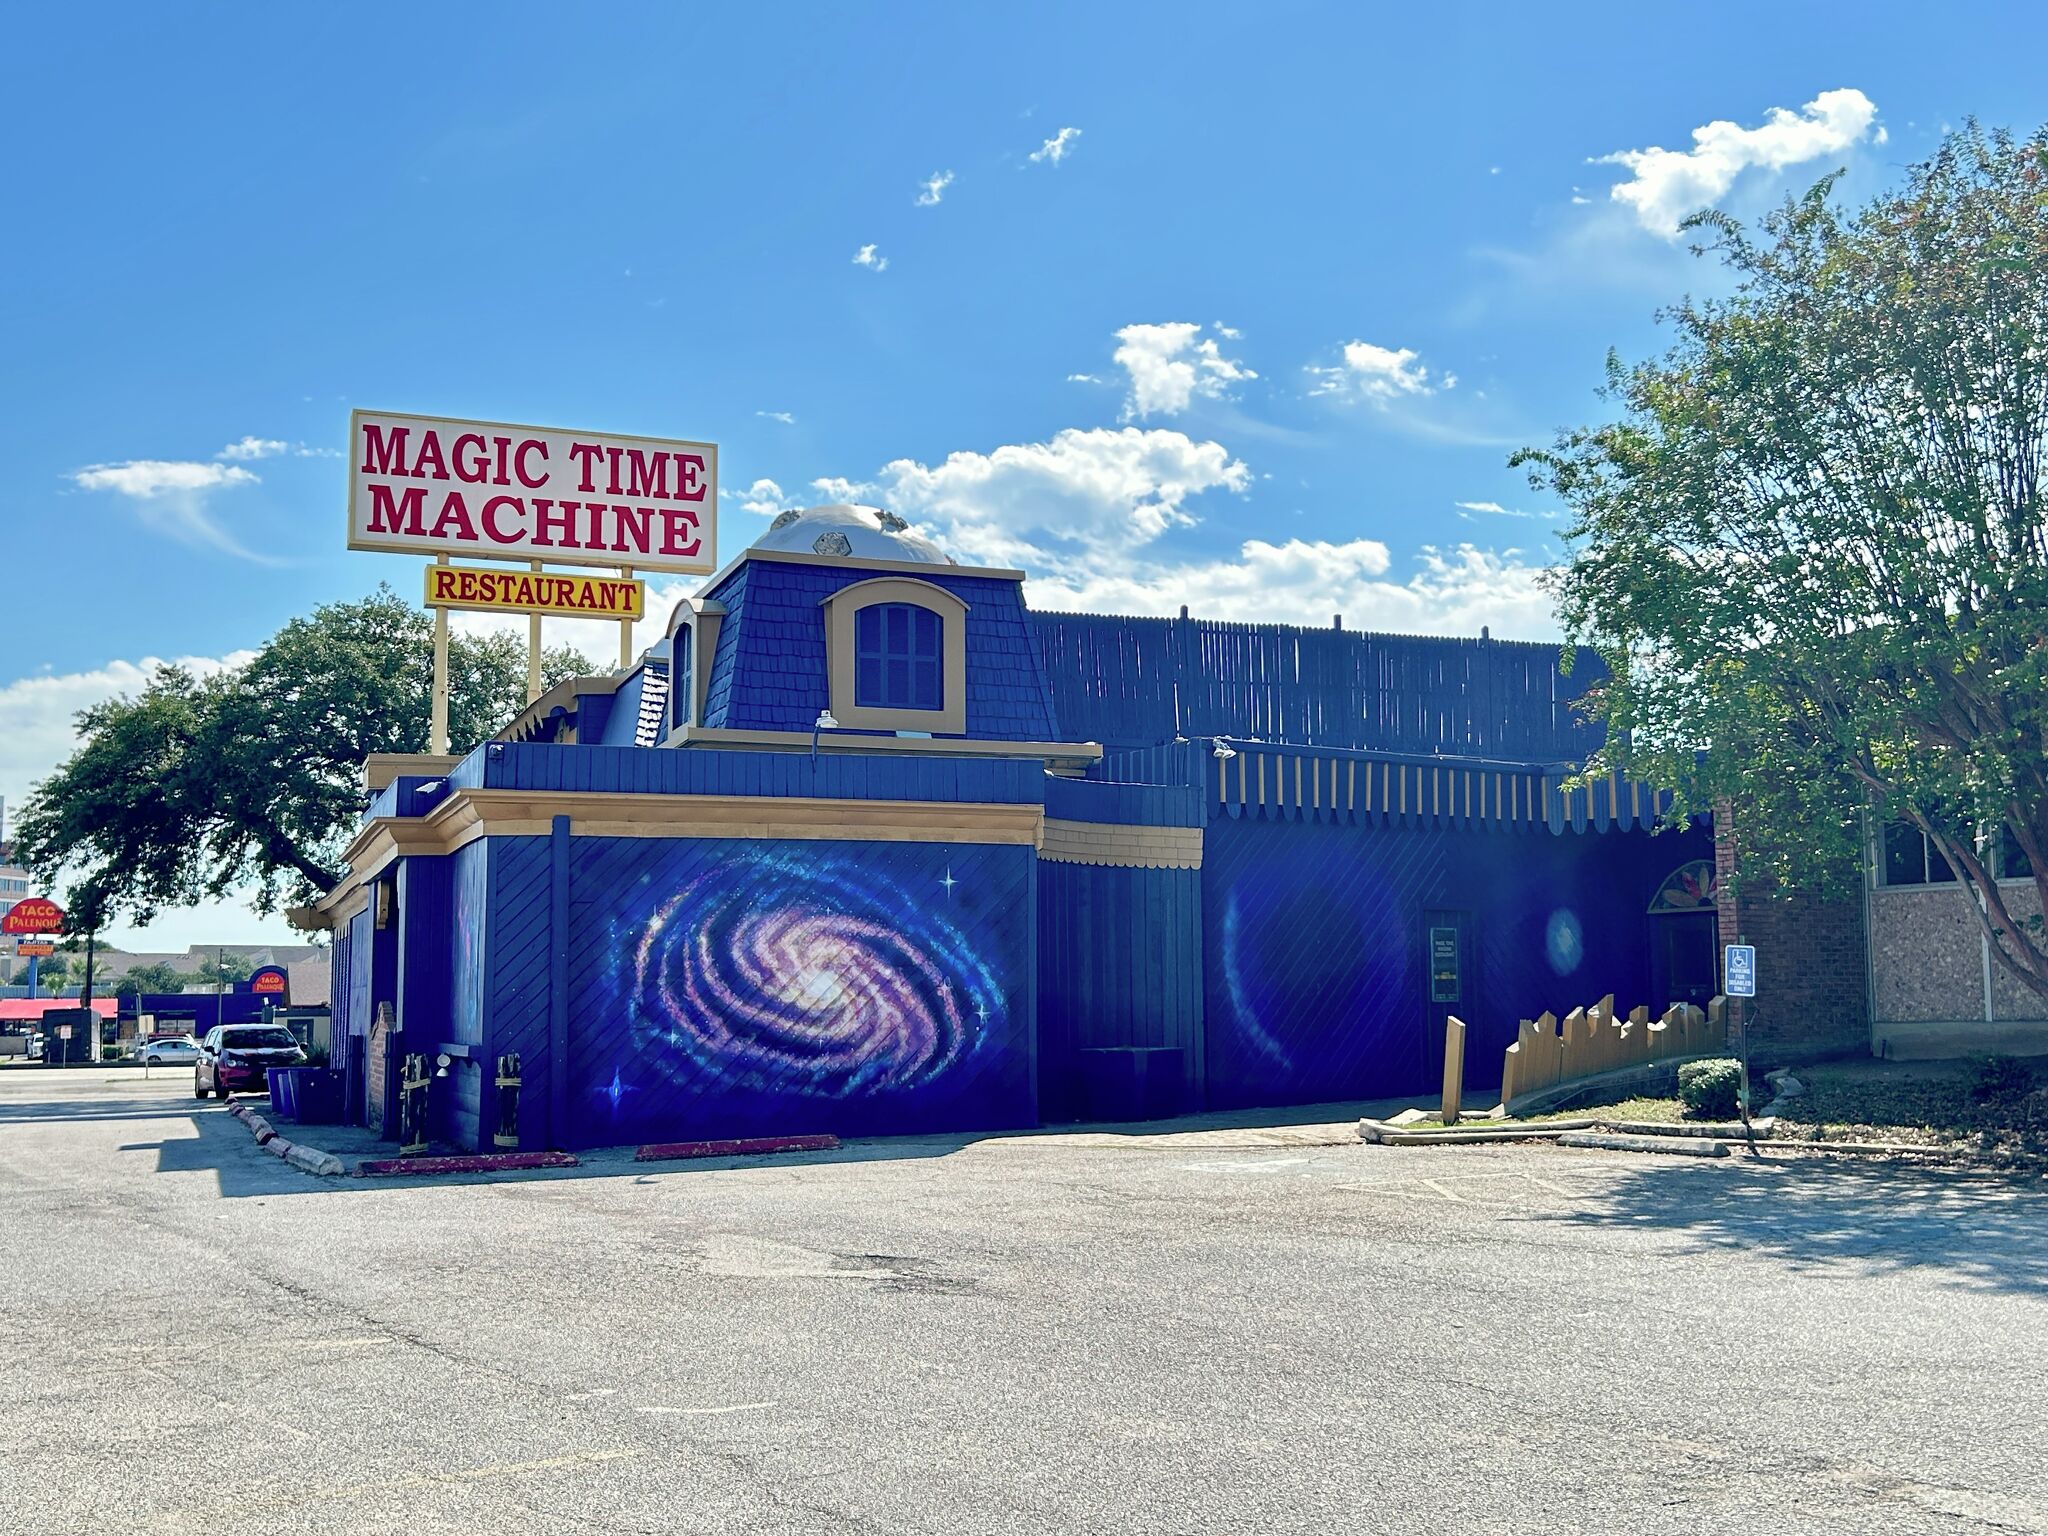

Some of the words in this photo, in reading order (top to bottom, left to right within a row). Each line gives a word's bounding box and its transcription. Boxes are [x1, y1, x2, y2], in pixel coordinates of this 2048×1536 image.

[361, 423, 551, 489] MAGIC
[569, 441, 708, 502] TIME
[366, 483, 703, 557] MACHINE
[434, 570, 638, 611] RESTAURANT
[20, 905, 56, 917] TACO
